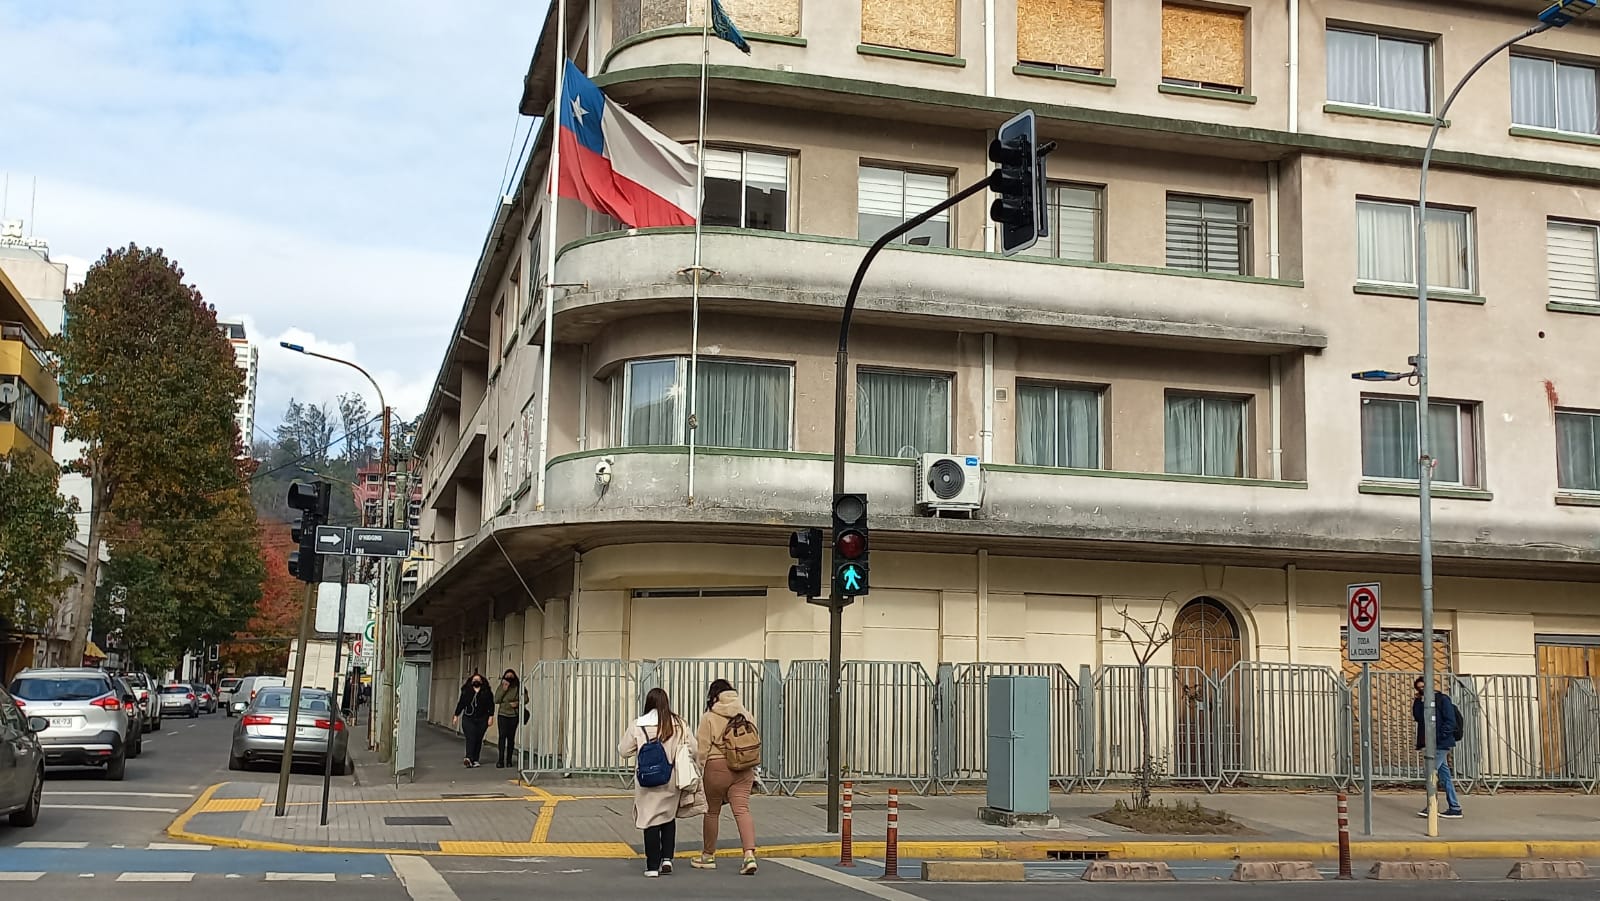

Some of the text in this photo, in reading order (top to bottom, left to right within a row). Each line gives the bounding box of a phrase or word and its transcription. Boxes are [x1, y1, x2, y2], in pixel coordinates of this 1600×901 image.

[1357, 637, 1370, 645] TODA
[1351, 648, 1377, 656] LA CUADRA
